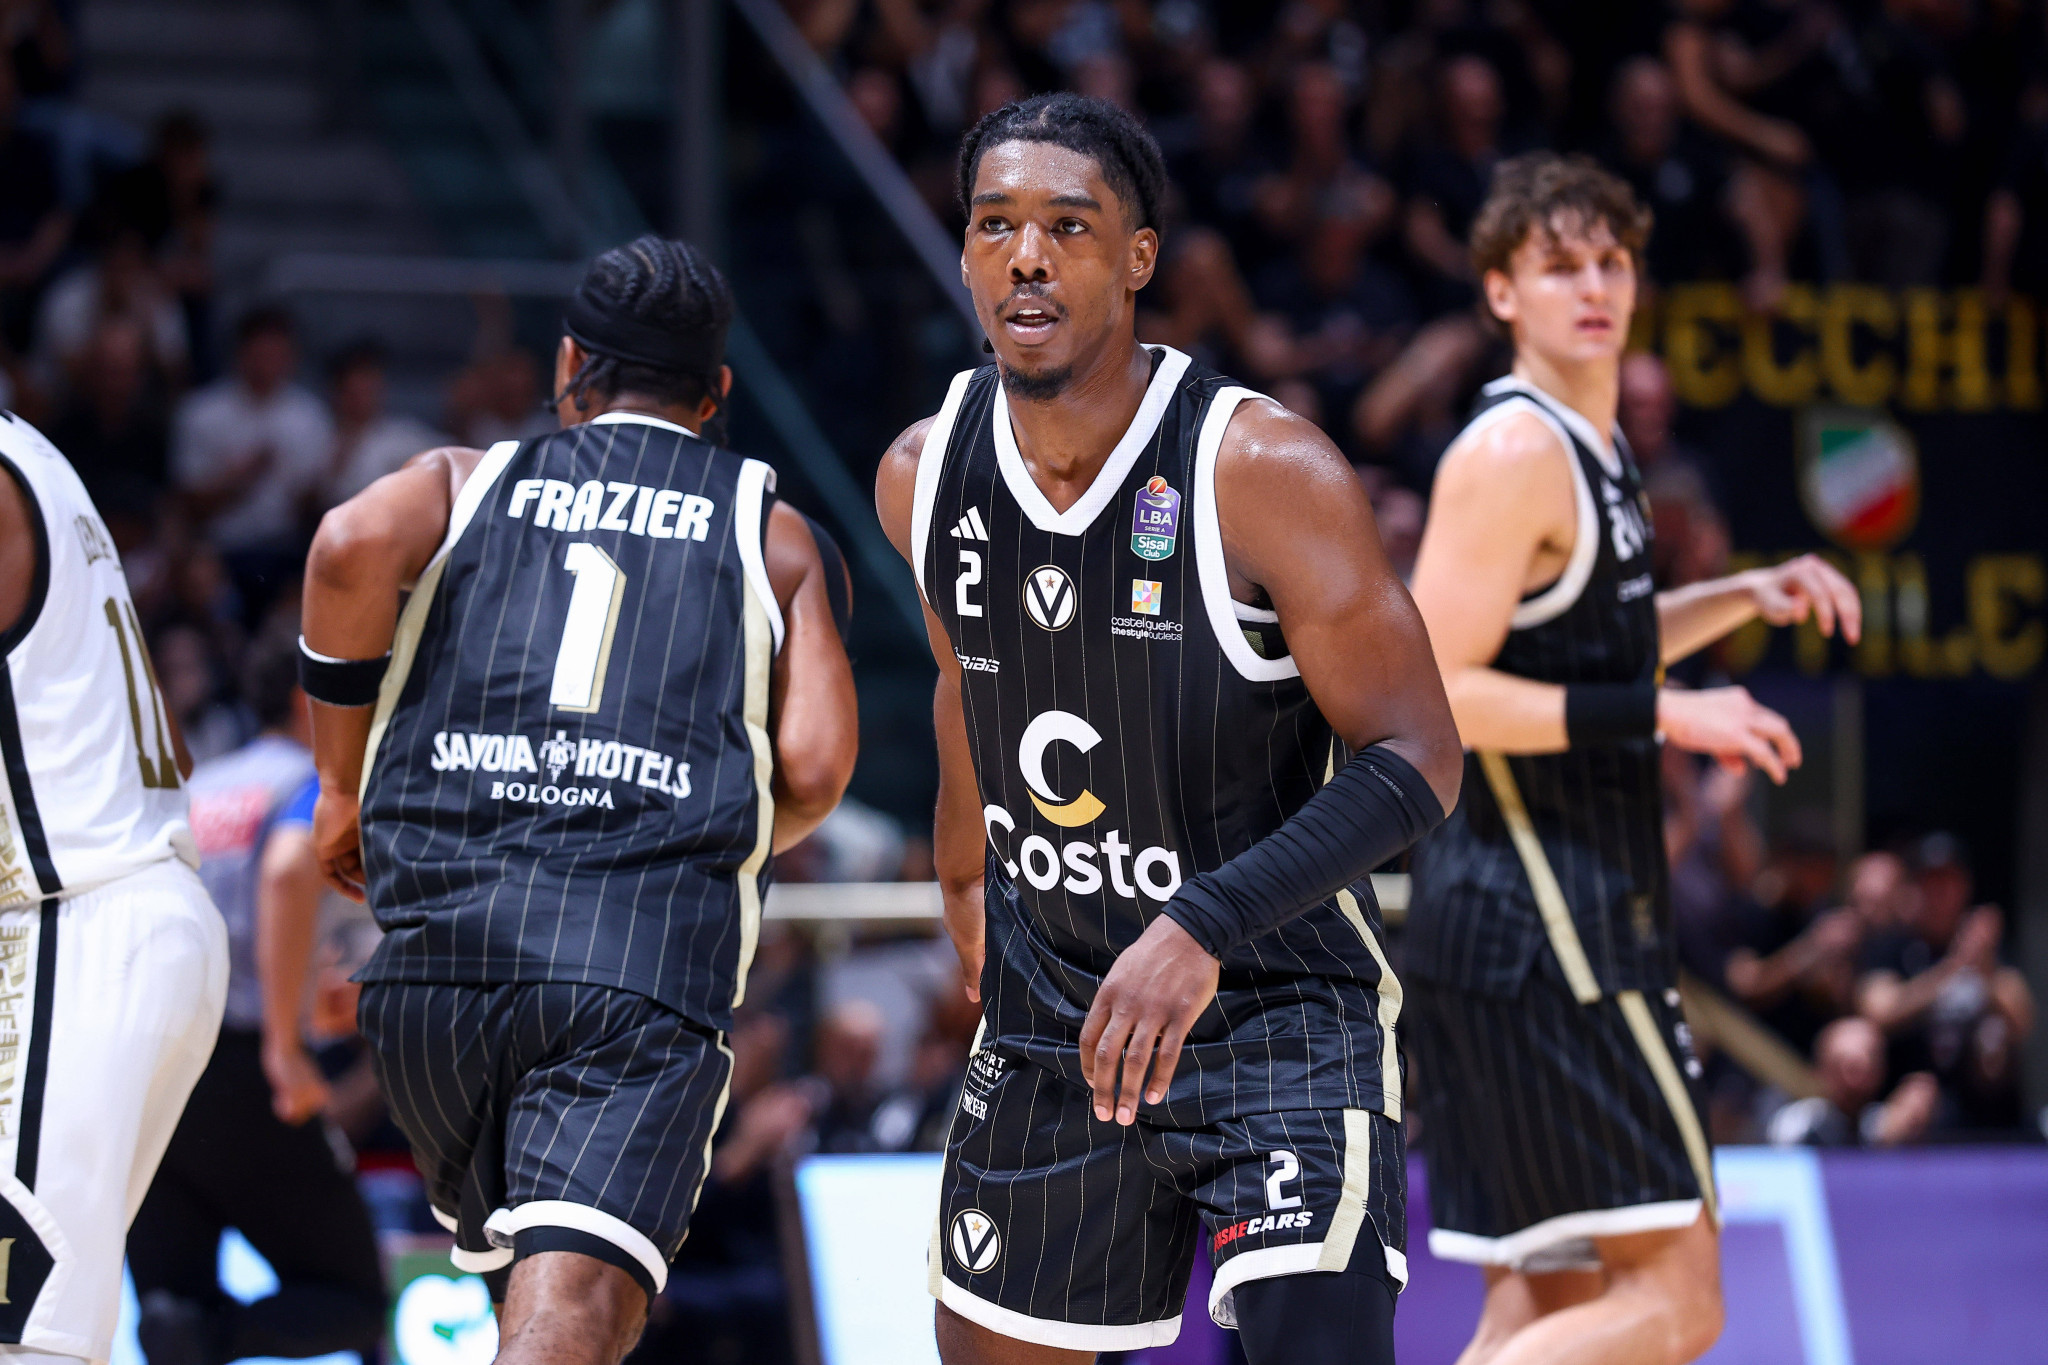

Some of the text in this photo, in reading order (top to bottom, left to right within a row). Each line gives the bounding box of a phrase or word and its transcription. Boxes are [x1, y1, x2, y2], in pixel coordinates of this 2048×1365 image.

[1628, 282, 2044, 410] ECCHI
[507, 478, 714, 542] FRAZIER
[1140, 510, 1173, 526] LBA
[1144, 525, 1160, 533] SERIE
[1137, 536, 1169, 551] Sisal
[1143, 549, 1161, 558] Club
[956, 550, 983, 618] 2
[550, 543, 627, 713] 1
[431, 730, 538, 773] SAVOIA
[574, 737, 692, 800] HOTELS
[490, 781, 616, 811] BOLOGNA
[983, 804, 1182, 902] Costa
[1266, 1149, 1302, 1210] 2
[1213, 1211, 1314, 1253] NSKECARS
